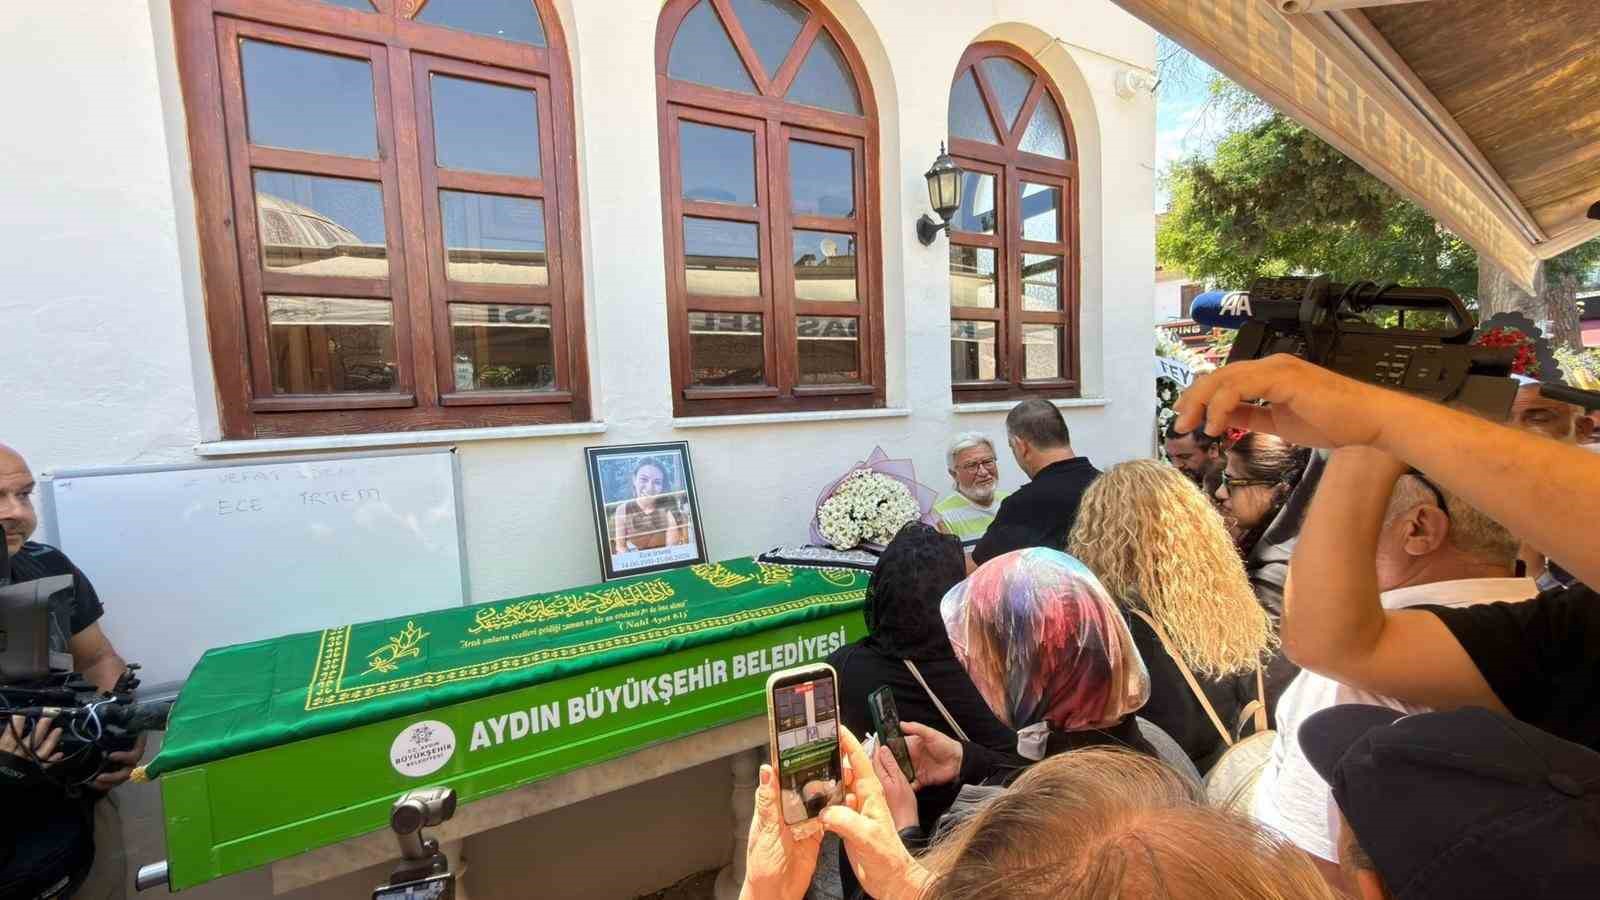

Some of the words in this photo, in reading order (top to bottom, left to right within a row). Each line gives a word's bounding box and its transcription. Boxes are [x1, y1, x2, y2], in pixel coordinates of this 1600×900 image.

[1219, 290, 1252, 316] AA
[217, 498, 264, 516] ECE
[469, 705, 561, 752] AYDIN
[567, 659, 729, 726] BÜYÜKŞEHİR
[733, 625, 846, 680] BELEDİYESİ
